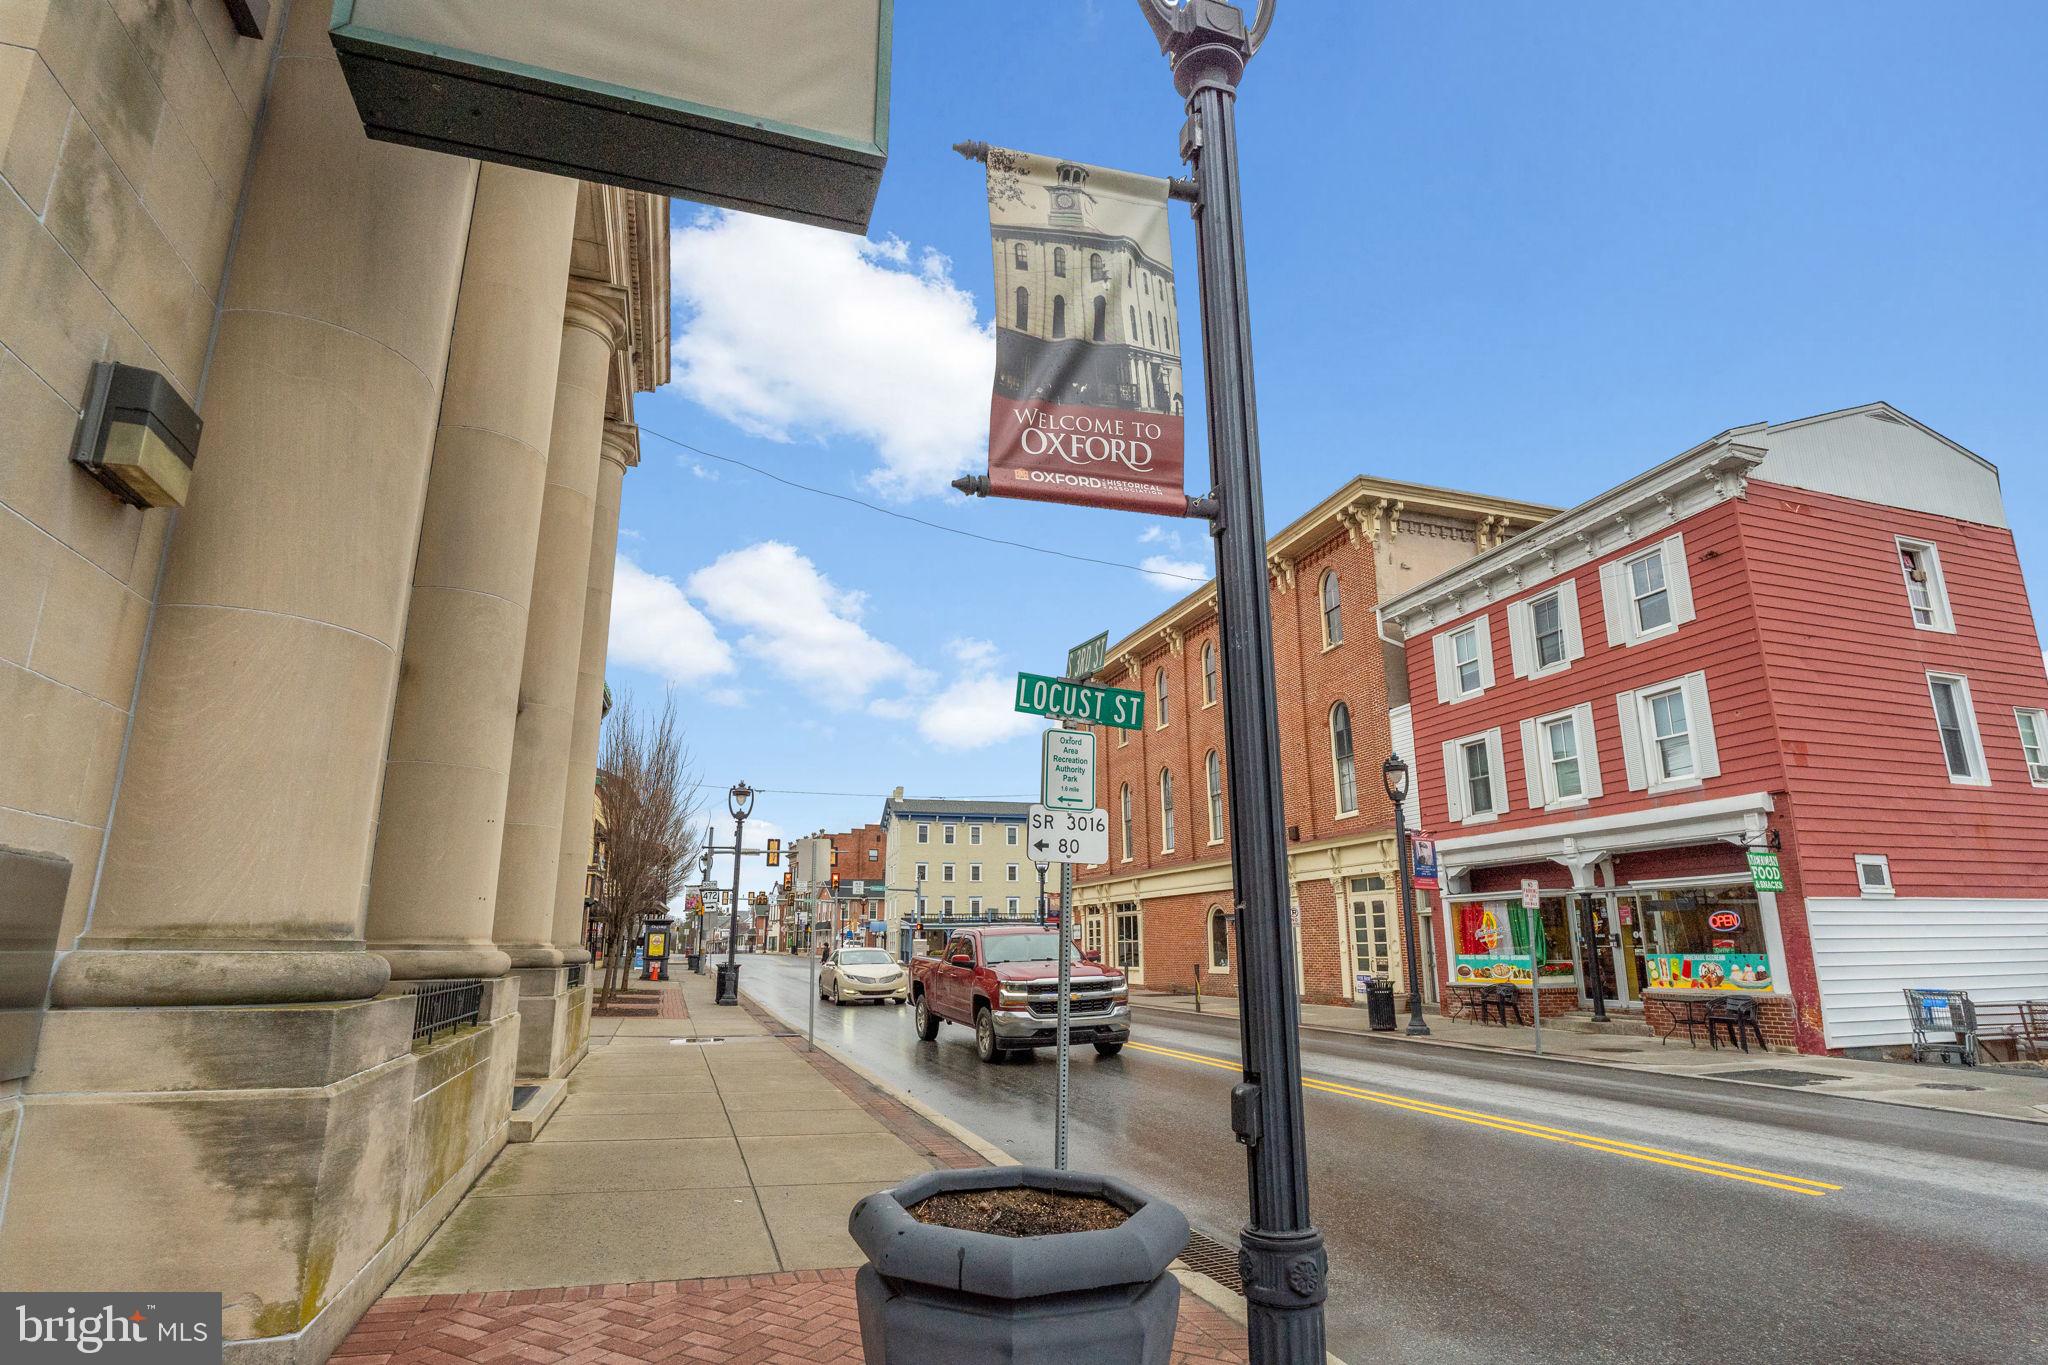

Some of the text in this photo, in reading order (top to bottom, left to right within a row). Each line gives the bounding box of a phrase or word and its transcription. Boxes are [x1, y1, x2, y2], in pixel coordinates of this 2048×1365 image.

[1014, 408, 1161, 440] WELCOME TO
[1021, 427, 1154, 473] OXFORD
[1031, 471, 1101, 488] OXFORD
[1107, 479, 1162, 492] HISTORICAL
[1066, 638, 1106, 678] S 3RD ST
[1019, 678, 1141, 725] LOCUST ST
[1060, 736, 1082, 745] Oxford
[1053, 755, 1088, 764] Recreation
[1055, 765, 1085, 775] Authority
[1032, 814, 1106, 832] SR 3016
[1058, 838, 1080, 854] 80
[1751, 866, 1781, 880] FOOD
[703, 891, 718, 900] 472
[1711, 914, 1738, 928] OPEN
